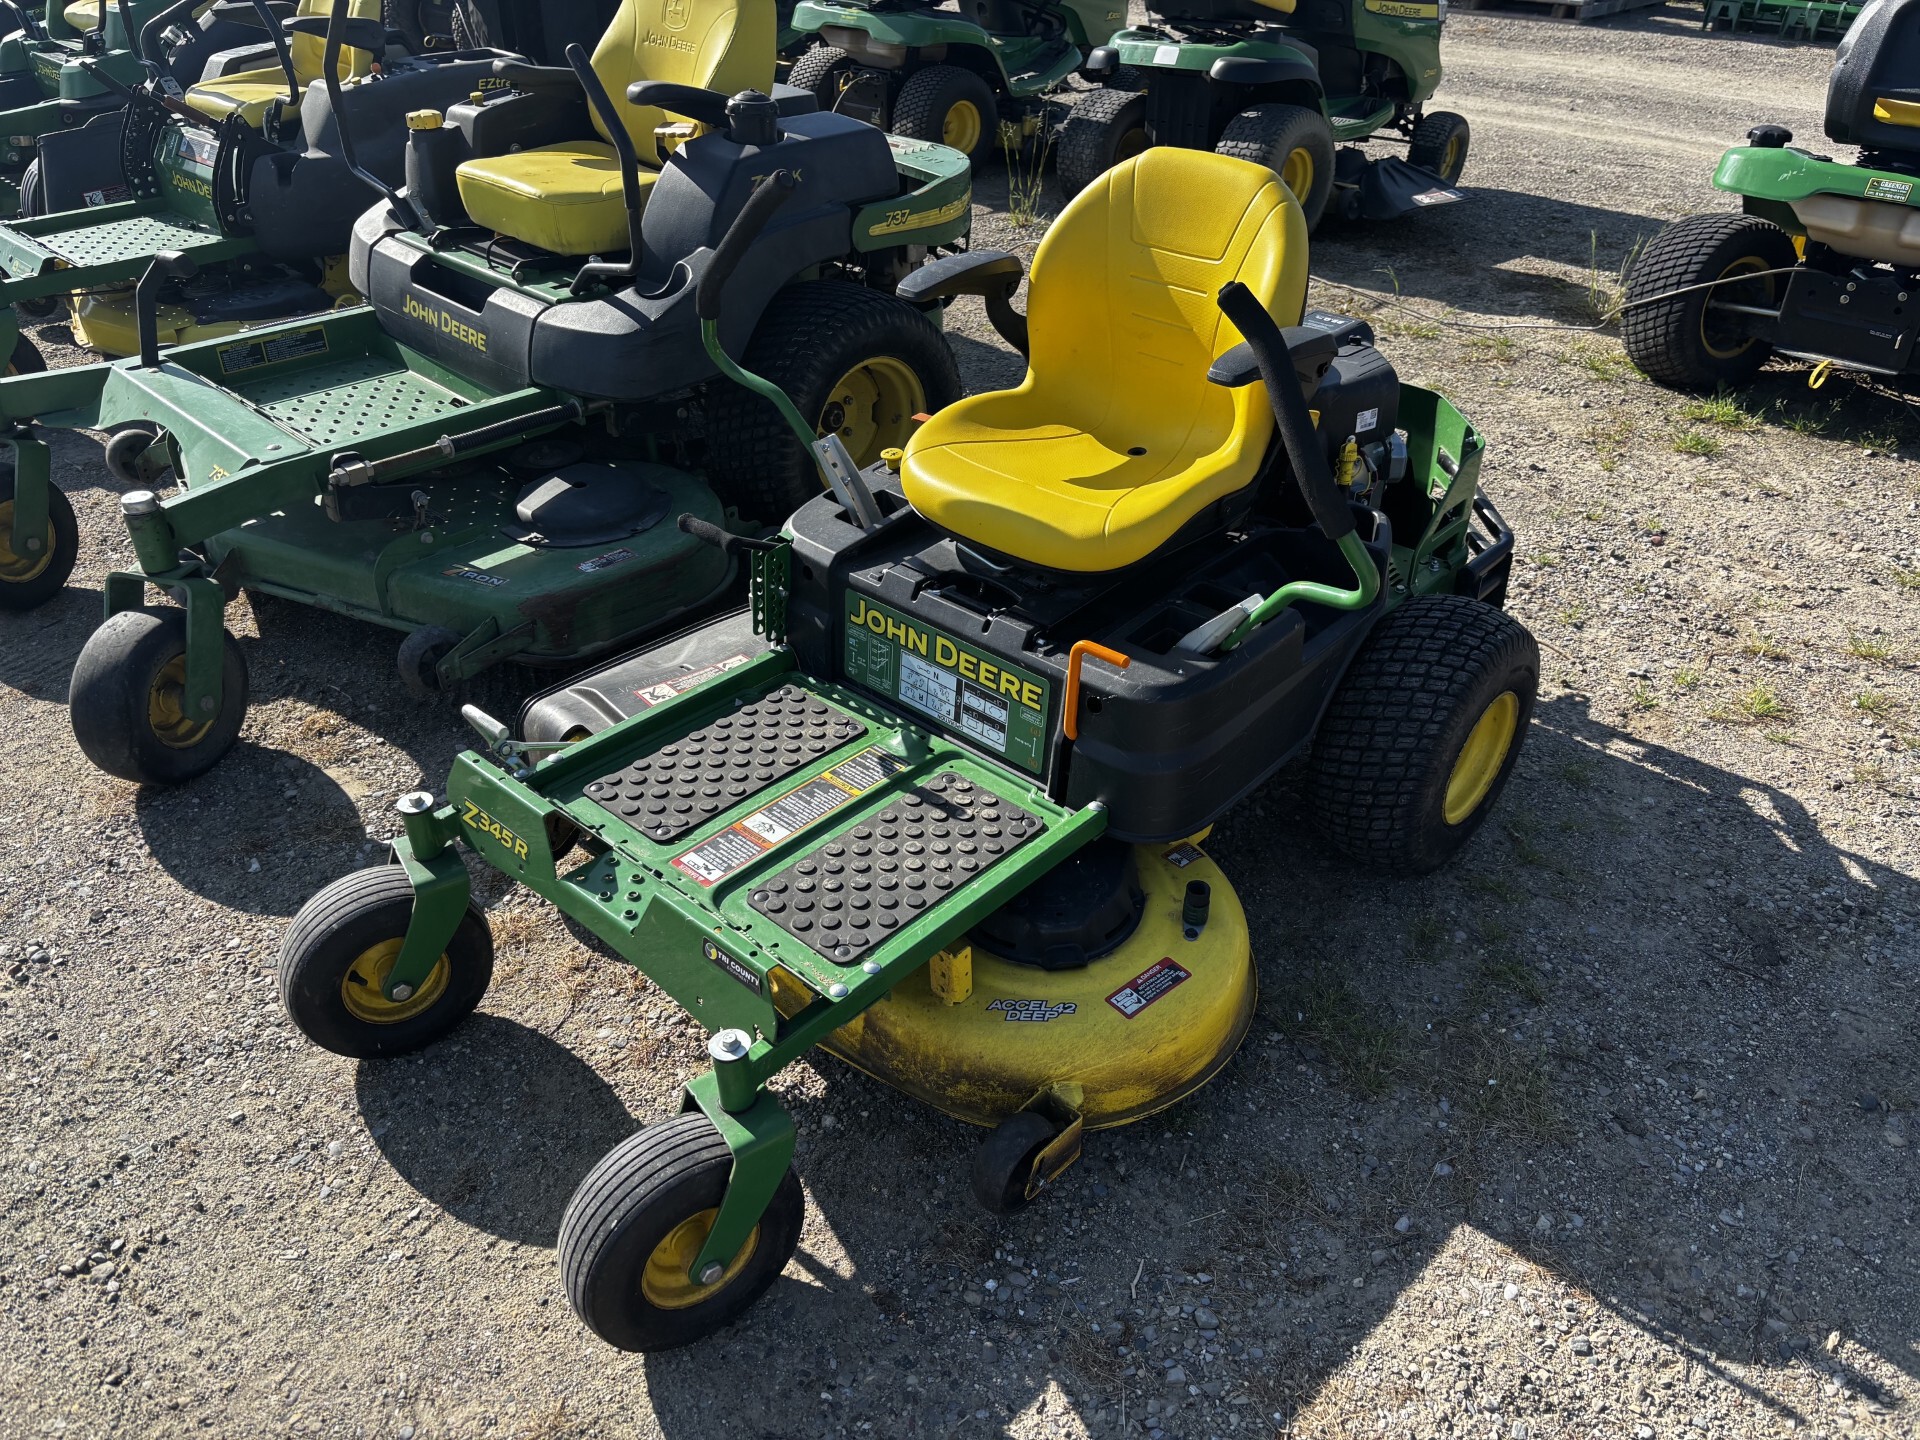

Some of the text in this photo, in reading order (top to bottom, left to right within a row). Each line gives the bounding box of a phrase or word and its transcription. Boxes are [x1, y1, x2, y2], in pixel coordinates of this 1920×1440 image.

[1376, 2, 1422, 17] JOHN DEERE
[642, 29, 697, 55] JOHN DEERE
[172, 170, 197, 194] JOHN
[885, 208, 911, 227] 737
[403, 294, 487, 352] JOHN DEERE
[459, 570, 504, 586] IRON
[850, 599, 928, 657] JOHN
[935, 635, 1043, 711] DEERE
[461, 799, 530, 862] Z345R
[717, 950, 760, 987] TRI COUNTY
[1140, 964, 1162, 981] DANGER
[986, 999, 1077, 1014] ACCEL 42
[1005, 1010, 1060, 1022] DEEP
